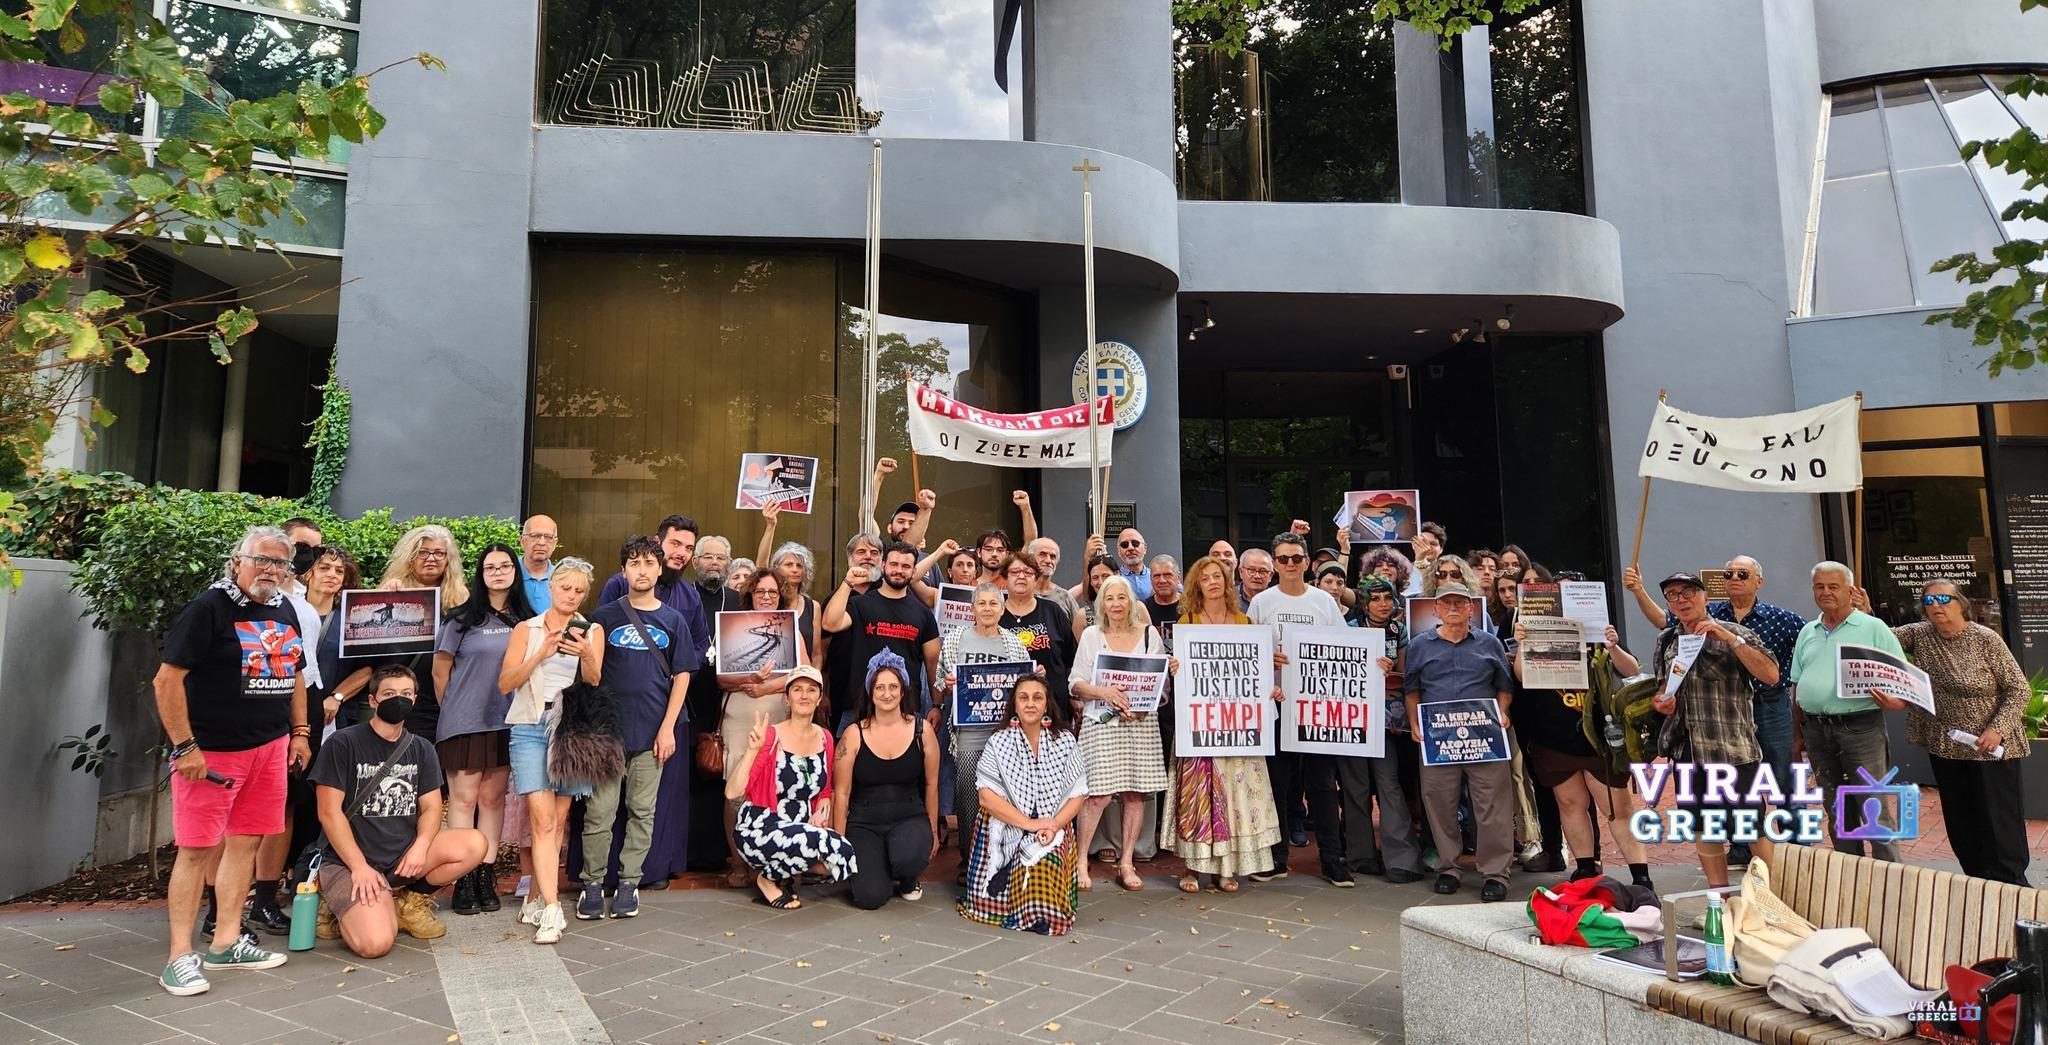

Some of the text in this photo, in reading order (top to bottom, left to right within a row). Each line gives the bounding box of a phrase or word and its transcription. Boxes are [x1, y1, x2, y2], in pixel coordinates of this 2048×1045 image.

[1103, 342, 1145, 377] ΠΡΟΞΕΝΕΙΟ
[1119, 385, 1143, 418] GENERAL
[940, 432, 1076, 459] ΟΙ ΖΩΕΣ ΜΑΣ
[1191, 643, 1258, 659] MELBOURNE
[1300, 644, 1366, 662] MELBOURNE
[1102, 672, 1110, 680] ΤΑ
[1112, 673, 1138, 682] ΚΕΡΔΗ
[1191, 660, 1260, 678] DEMANDS
[1300, 662, 1367, 679] DEMANDS
[1864, 663, 1897, 674] ΚΕΡΔΗ
[1877, 671, 1901, 682] ΖΩΕΣ
[972, 674, 985, 683] ΤΑ
[1192, 678, 1260, 698] JUSTICE
[1299, 676, 1366, 699] JUSTICE
[1190, 703, 1262, 732] TEMPI
[1296, 700, 1368, 731] TEMPI
[1435, 711, 1486, 722] ΤΑ ΚΕΡΔΗ
[1200, 730, 1255, 746] VICTIMS
[1305, 726, 1360, 743] VICTIMS
